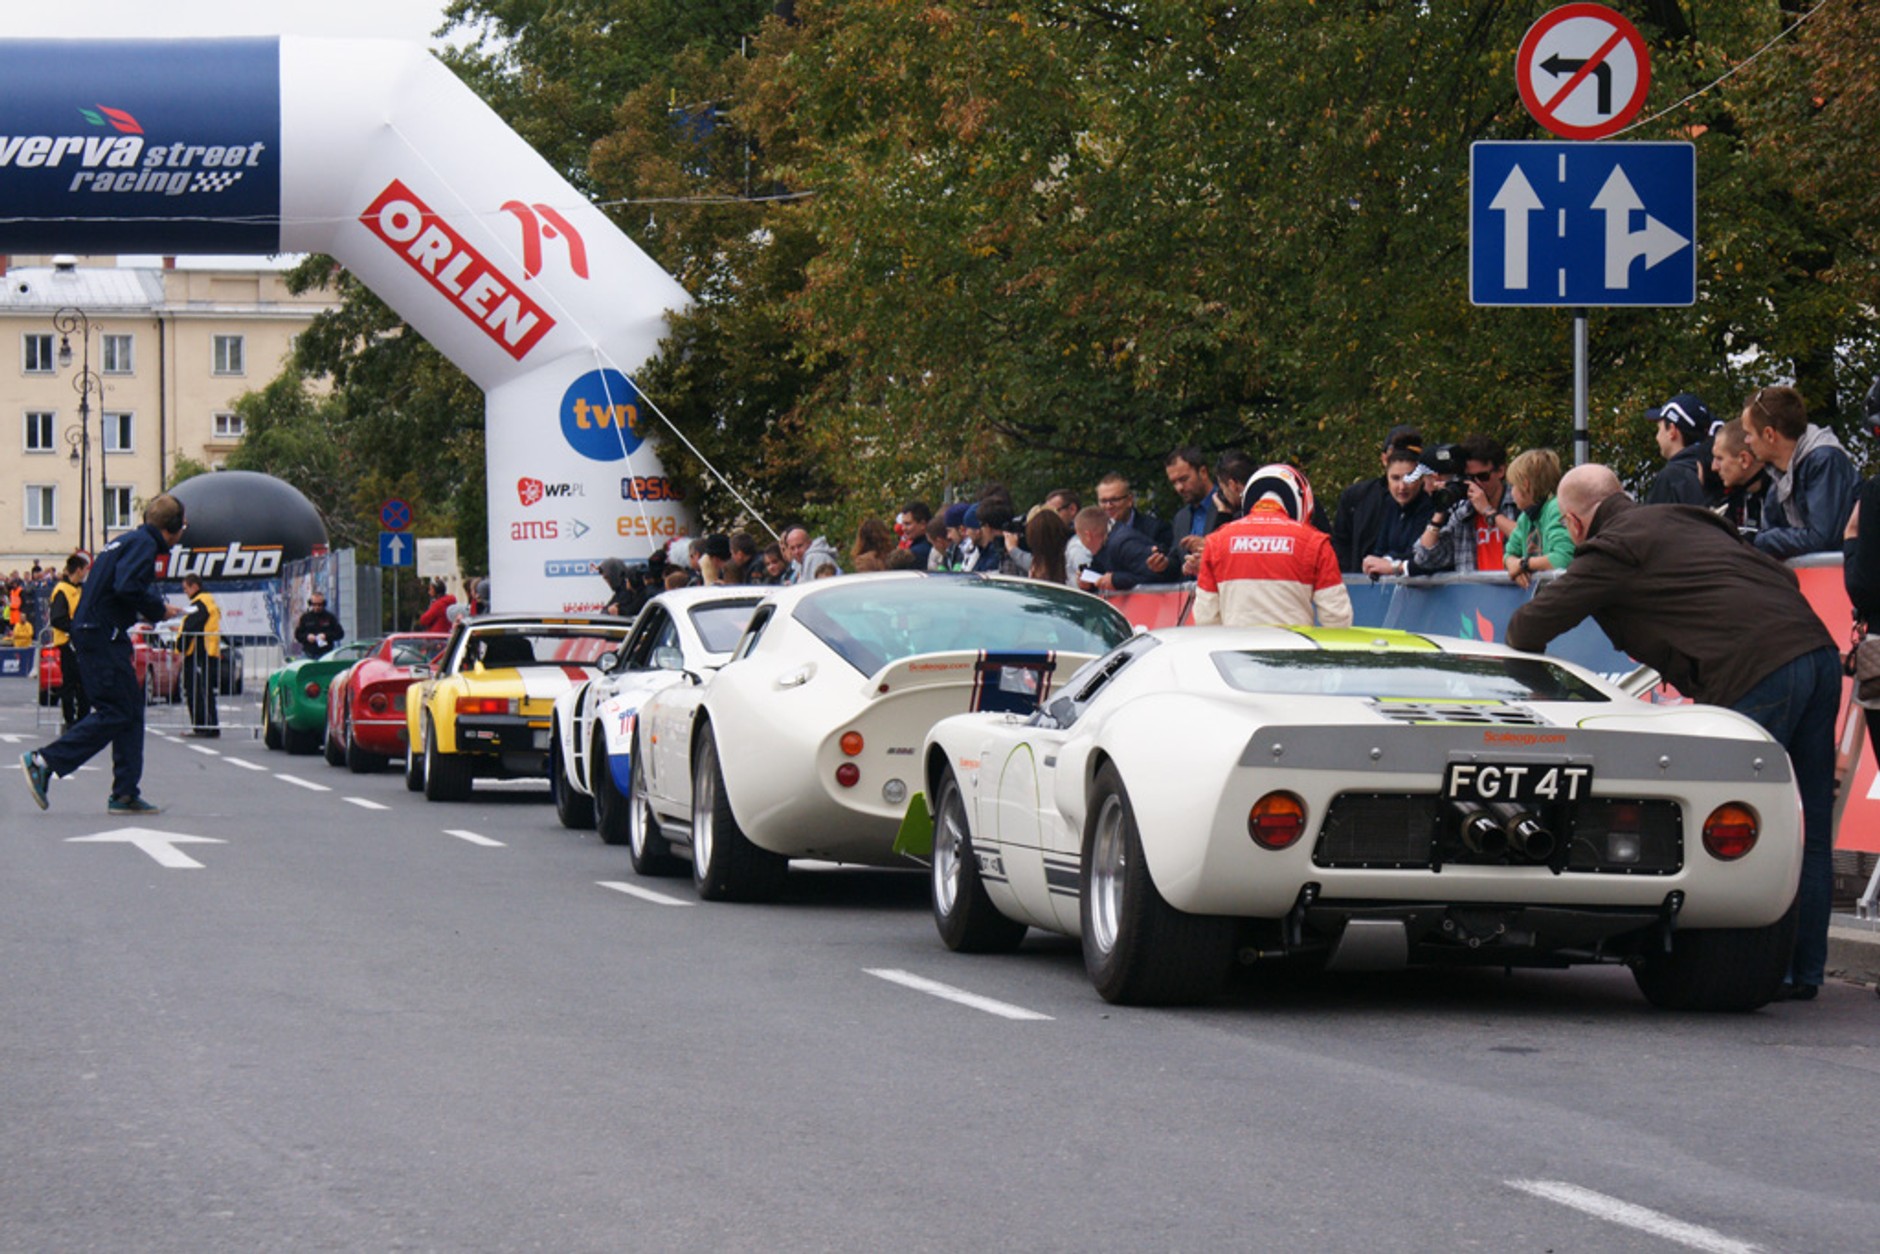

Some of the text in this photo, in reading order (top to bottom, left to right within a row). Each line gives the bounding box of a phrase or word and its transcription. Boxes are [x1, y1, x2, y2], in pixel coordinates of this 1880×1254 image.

[0, 136, 265, 168] verva street
[69, 168, 192, 196] racing
[379, 200, 540, 347] ORLEN
[573, 398, 636, 429] tvn
[545, 483, 586, 498] WP.PL
[511, 520, 558, 541] ams
[1233, 537, 1291, 553] MOTUL
[167, 541, 283, 578] turbo
[1449, 765, 1588, 800] FGT 4T
